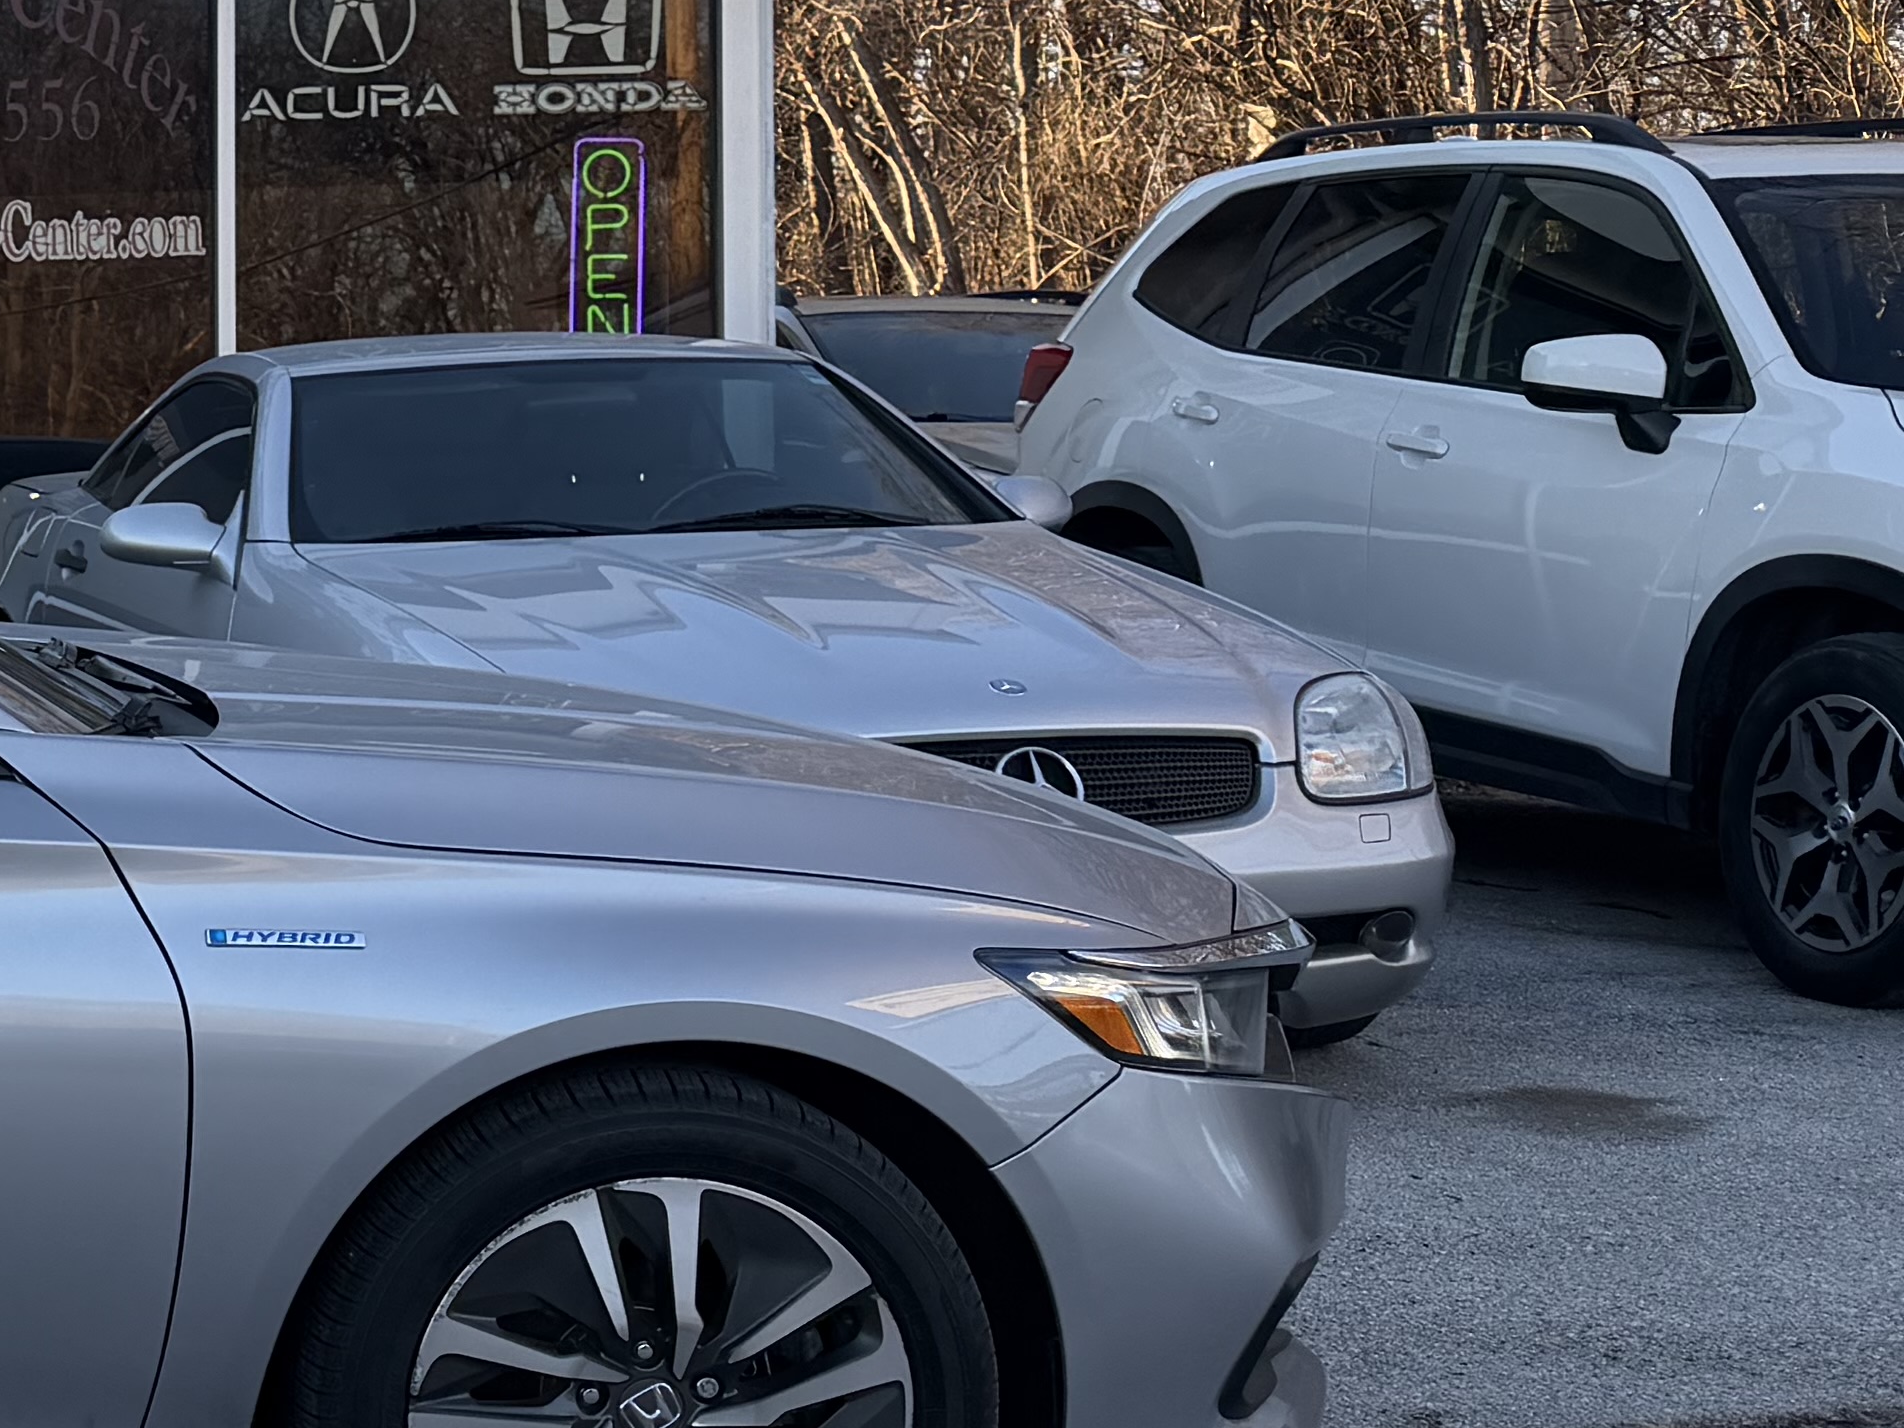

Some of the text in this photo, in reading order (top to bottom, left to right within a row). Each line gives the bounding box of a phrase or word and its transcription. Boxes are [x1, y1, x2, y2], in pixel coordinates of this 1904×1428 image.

[241, 82, 460, 122] ACURA
[492, 79, 708, 115] HONDA
[582, 148, 632, 334] OPEN
[230, 931, 356, 945] HYBRID
